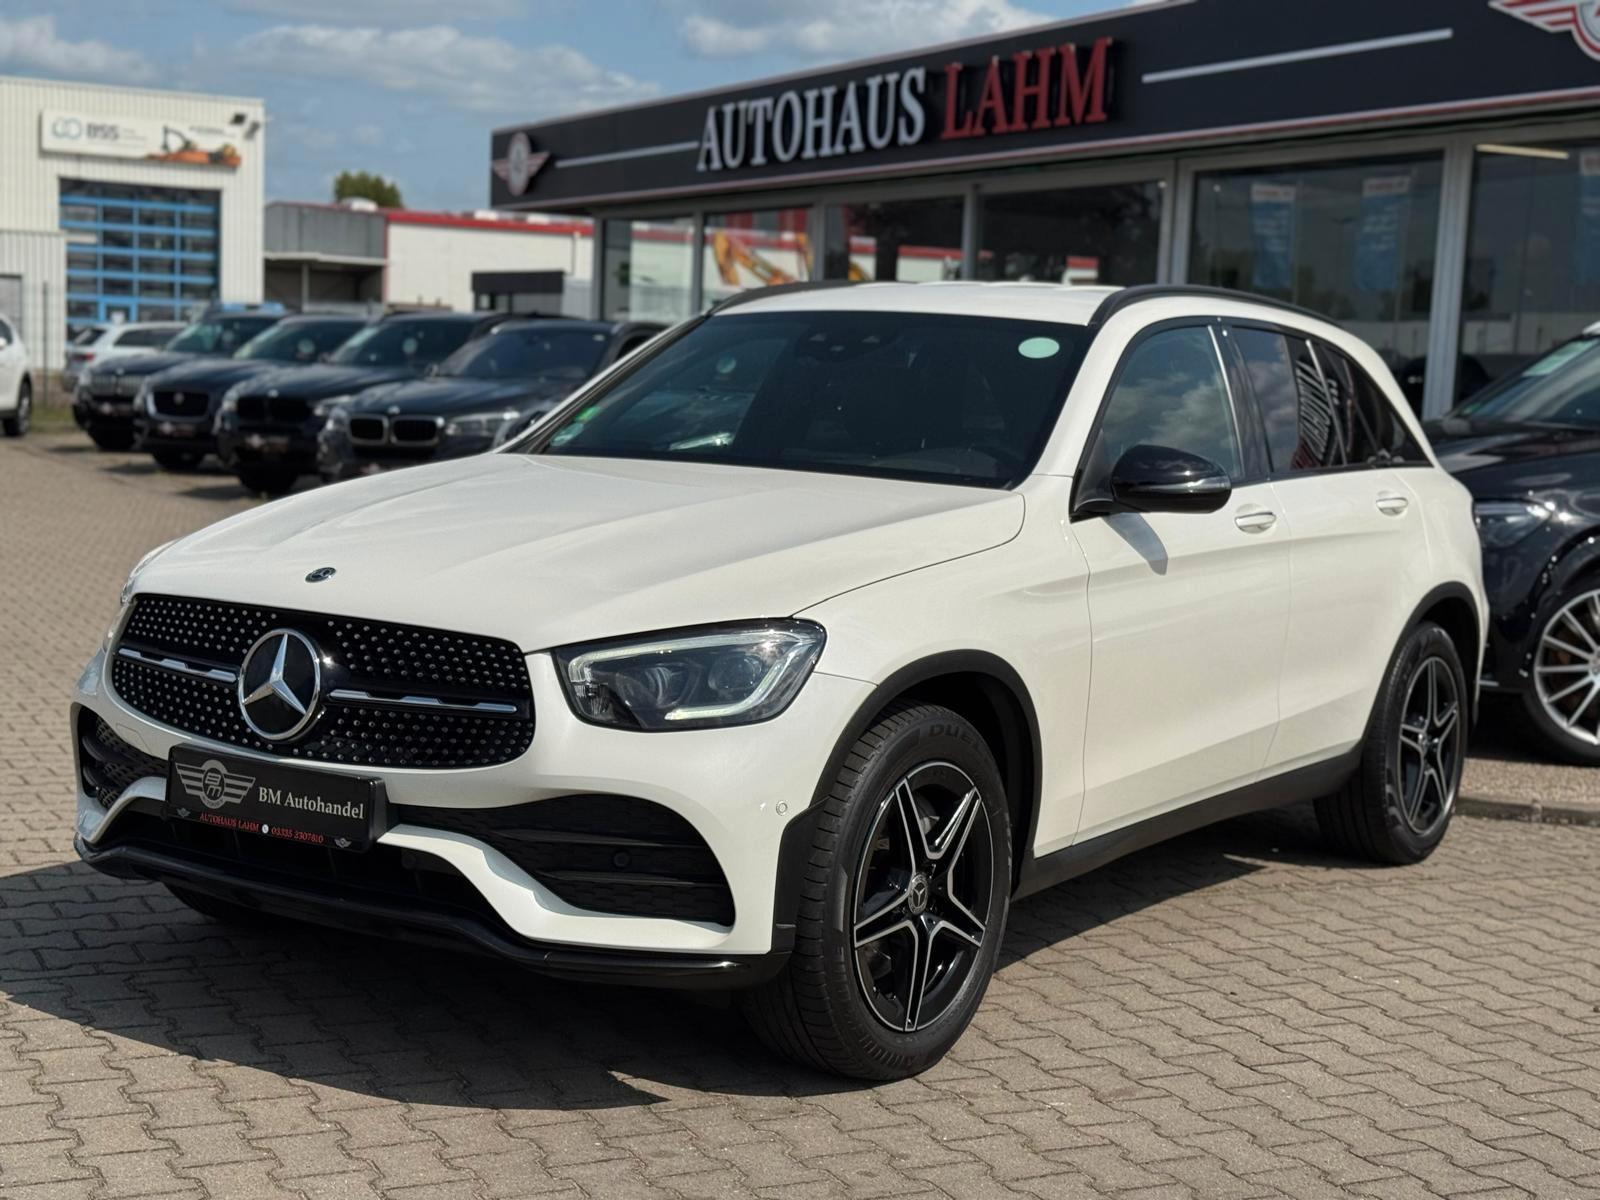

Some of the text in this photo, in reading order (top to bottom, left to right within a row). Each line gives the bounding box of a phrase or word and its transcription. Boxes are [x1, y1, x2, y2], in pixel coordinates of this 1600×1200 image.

[697, 36, 1113, 171] AUTOHAUS LAHM
[258, 786, 364, 820] BM Autohandel
[199, 813, 237, 828] AUTOHAUS
[238, 820, 259, 833] LAHM
